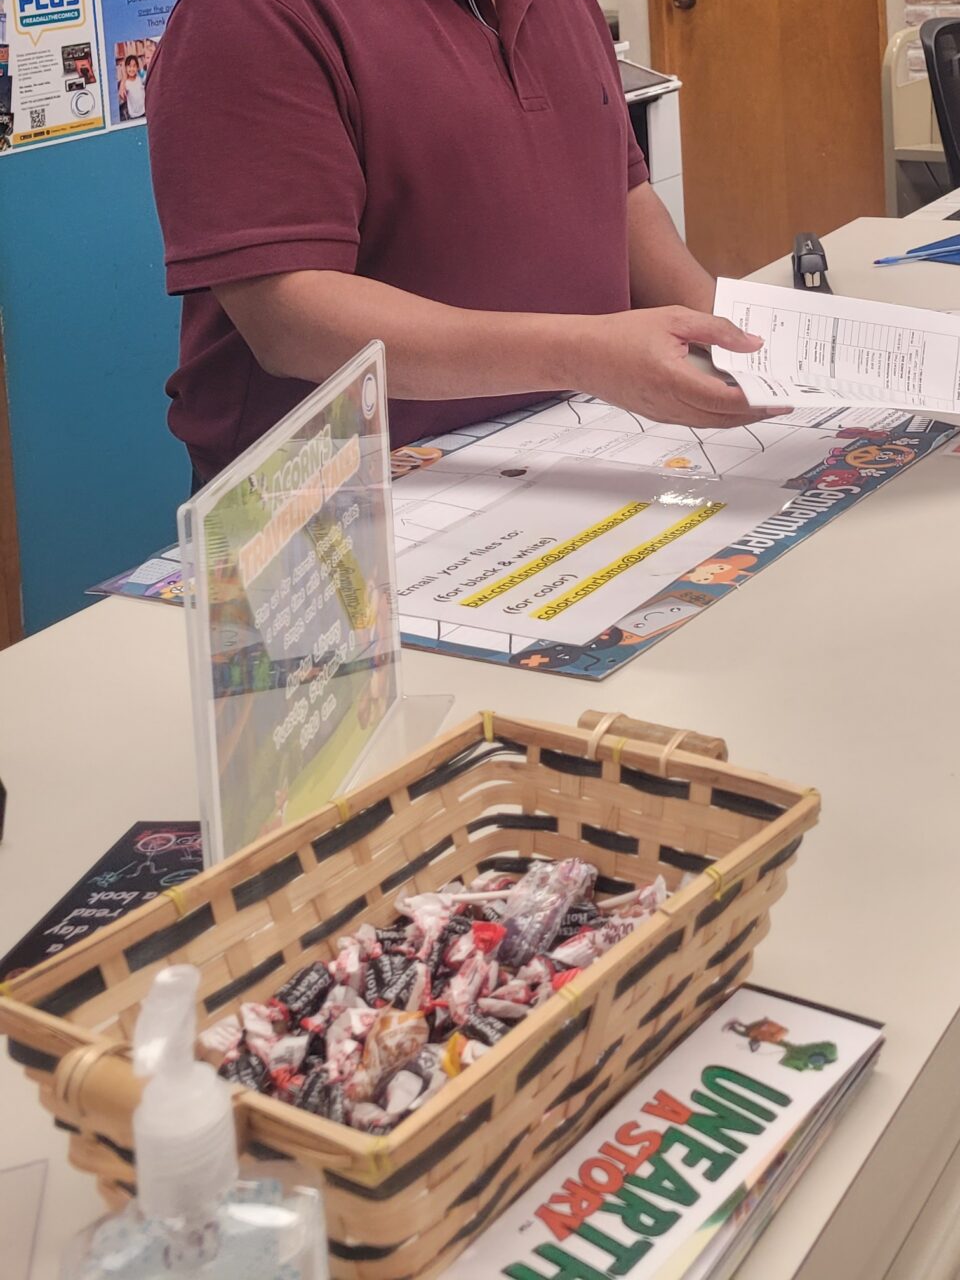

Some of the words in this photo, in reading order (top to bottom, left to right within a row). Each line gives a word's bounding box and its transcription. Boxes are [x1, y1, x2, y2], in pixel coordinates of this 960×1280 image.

[731, 482, 861, 555] September
[398, 574, 439, 597] Email
[440, 554, 473, 577] your
[469, 538, 501, 562] files
[500, 527, 524, 542] to:
[432, 586, 463, 604] (for
[463, 565, 504, 590] black
[497, 557, 514, 569] &
[513, 535, 558, 565] white)
[502, 596, 533, 616] (for
[533, 572, 580, 600] color)
[62, 908, 124, 922] read
[88, 891, 140, 905] book
[43, 921, 89, 940] day
[641, 1089, 695, 1126] A
[534, 1121, 662, 1241] STORY
